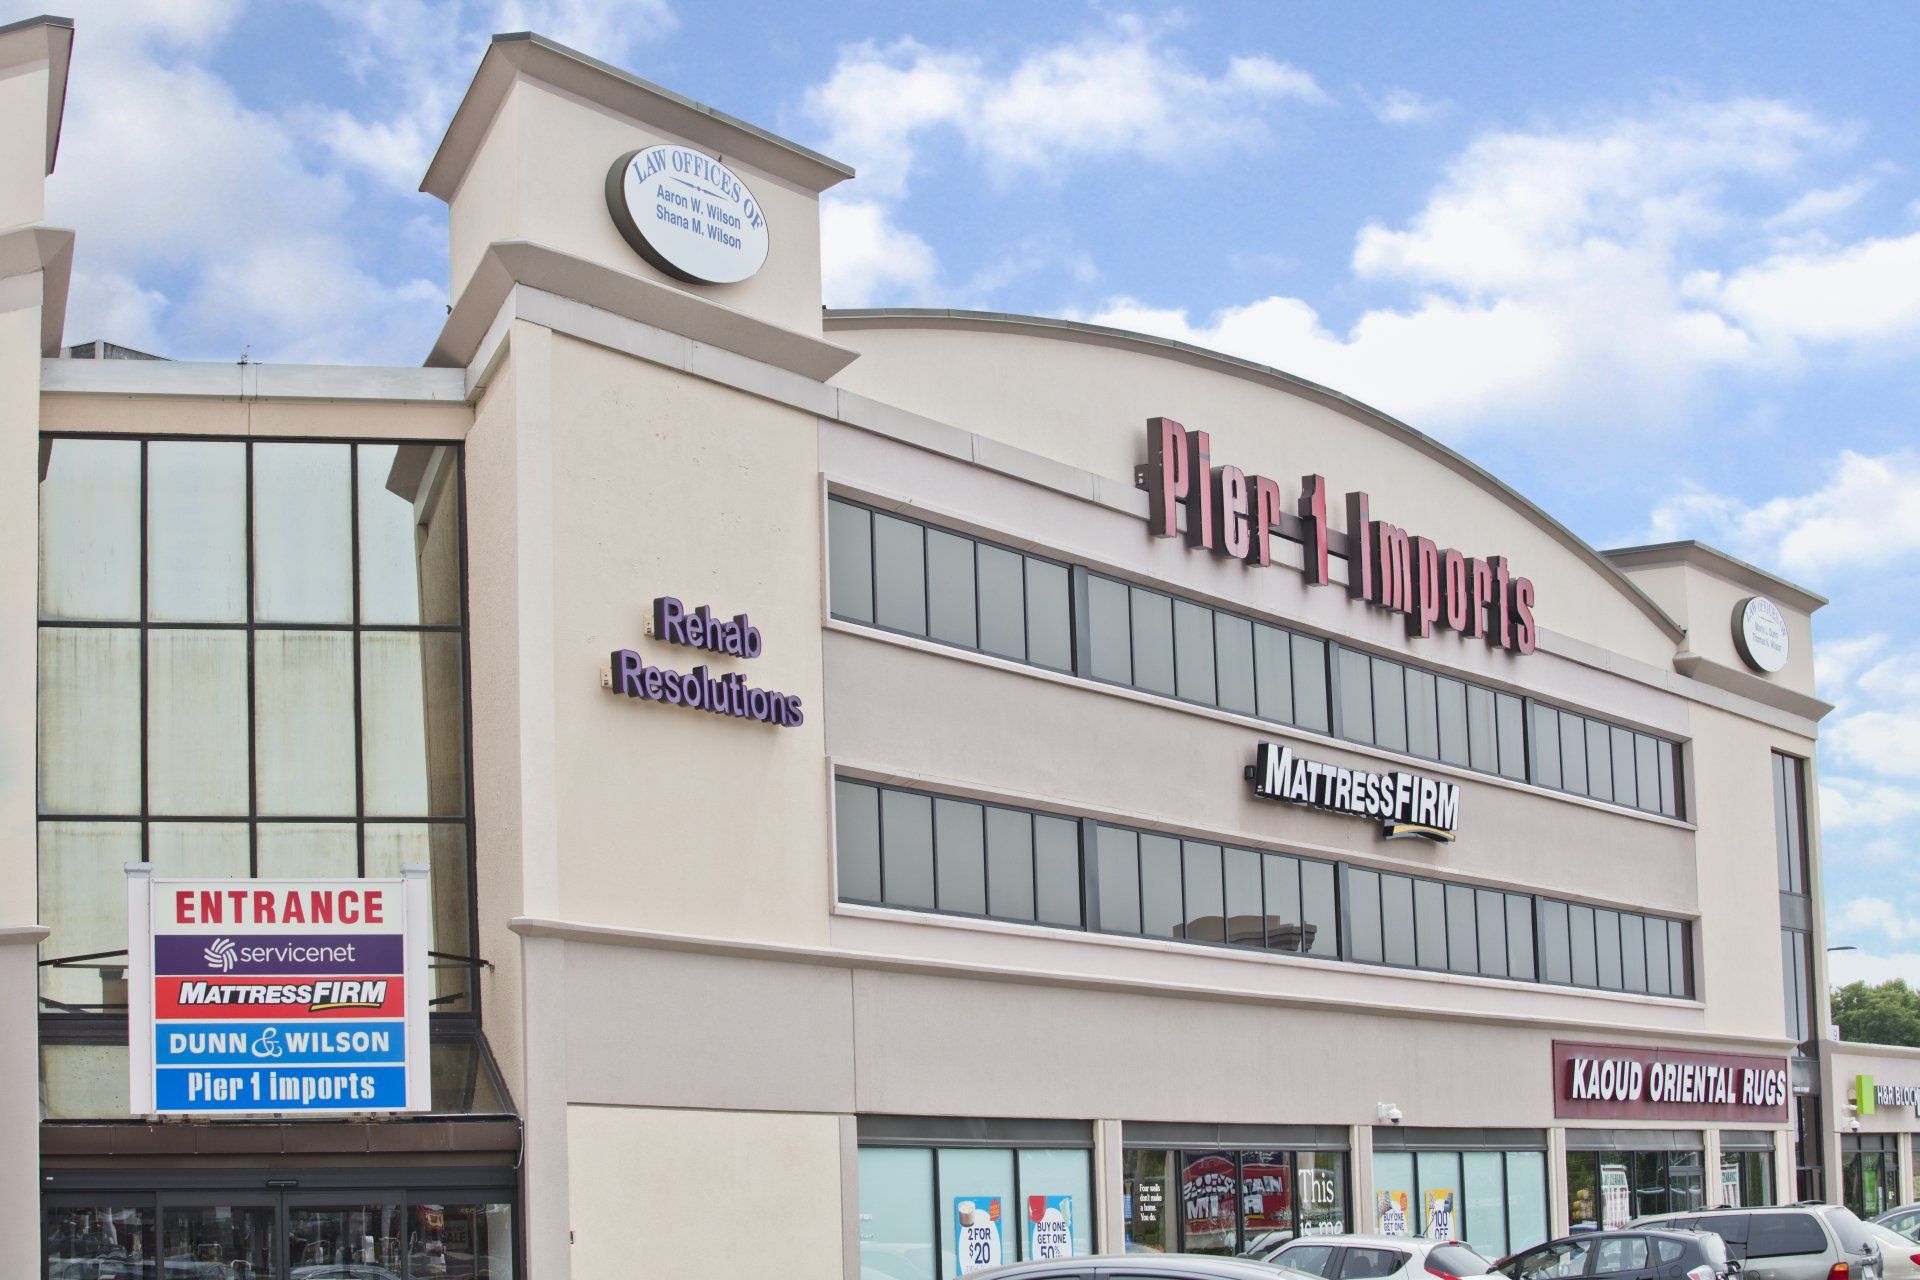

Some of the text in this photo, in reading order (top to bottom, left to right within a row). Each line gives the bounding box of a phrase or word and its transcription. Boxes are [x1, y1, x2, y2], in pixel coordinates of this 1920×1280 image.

[633, 149, 763, 230] LAW OFFICES OF
[657, 184, 741, 230] Aaron W. Wilson
[656, 204, 742, 250] Shana M. Wilson
[1299, 473, 1329, 587] 1
[654, 596, 762, 659] Rehab
[611, 649, 803, 727] Resolutions
[176, 891, 384, 924] ENTRANCE
[240, 943, 356, 963] servicenet
[170, 1027, 389, 1058] DUNN & WILSON
[188, 1072, 375, 1105] Pier 1 imports
[1571, 1058, 1787, 1106] KAOUD ORIENTAL RUGS
[1875, 1085, 1895, 1106] H&R
[1298, 1168, 1334, 1203] This
[1037, 1221, 1067, 1232] BUY ONE
[1383, 1212, 1404, 1222] BUY ONE
[968, 1227, 992, 1241] 2 FOR
[1037, 1233, 1067, 1244] GET ONE
[969, 1241, 991, 1265] $20
